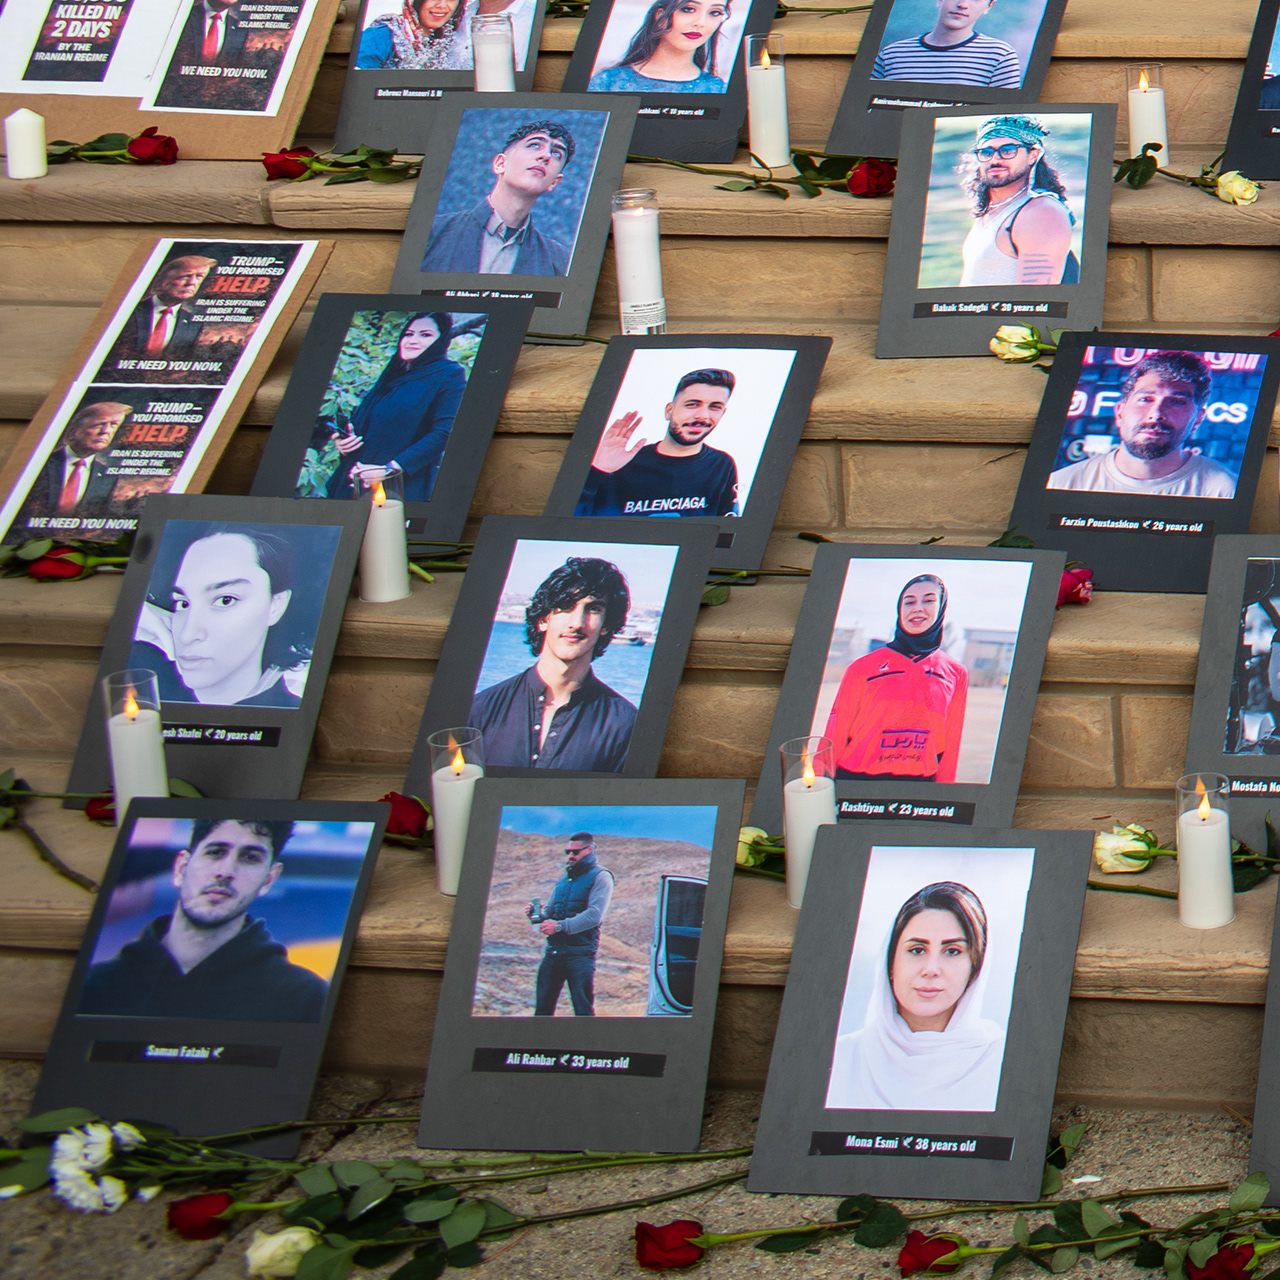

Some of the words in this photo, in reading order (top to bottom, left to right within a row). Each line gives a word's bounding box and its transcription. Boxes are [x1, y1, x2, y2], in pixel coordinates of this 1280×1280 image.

[55, 5, 102, 19] KILLED
[104, 5, 122, 20] IN
[52, 21, 63, 37] 2
[66, 22, 110, 38] DAYS
[58, 43, 72, 51] BY
[74, 43, 91, 51] THE
[35, 52, 72, 61] IRANIAN
[74, 52, 108, 62] REGIME
[181, 66, 195, 75] WE
[197, 66, 221, 77] NEED
[222, 68, 240, 77] YOU
[241, 69, 267, 78] NOW.
[624, 496, 706, 513] BALENCIAGA
[1232, 781, 1267, 792] Mostafa
[507, 1053, 520, 1064] Ali
[522, 1054, 556, 1065] Rahbar
[572, 1056, 585, 1067] 33
[586, 1059, 612, 1069] years
[614, 1057, 629, 1068] old
[846, 1135, 872, 1147] Mona
[875, 1137, 899, 1148] Esmi
[915, 1138, 929, 1150] 38
[931, 1142, 957, 1152] years
[960, 1140, 976, 1151] old
